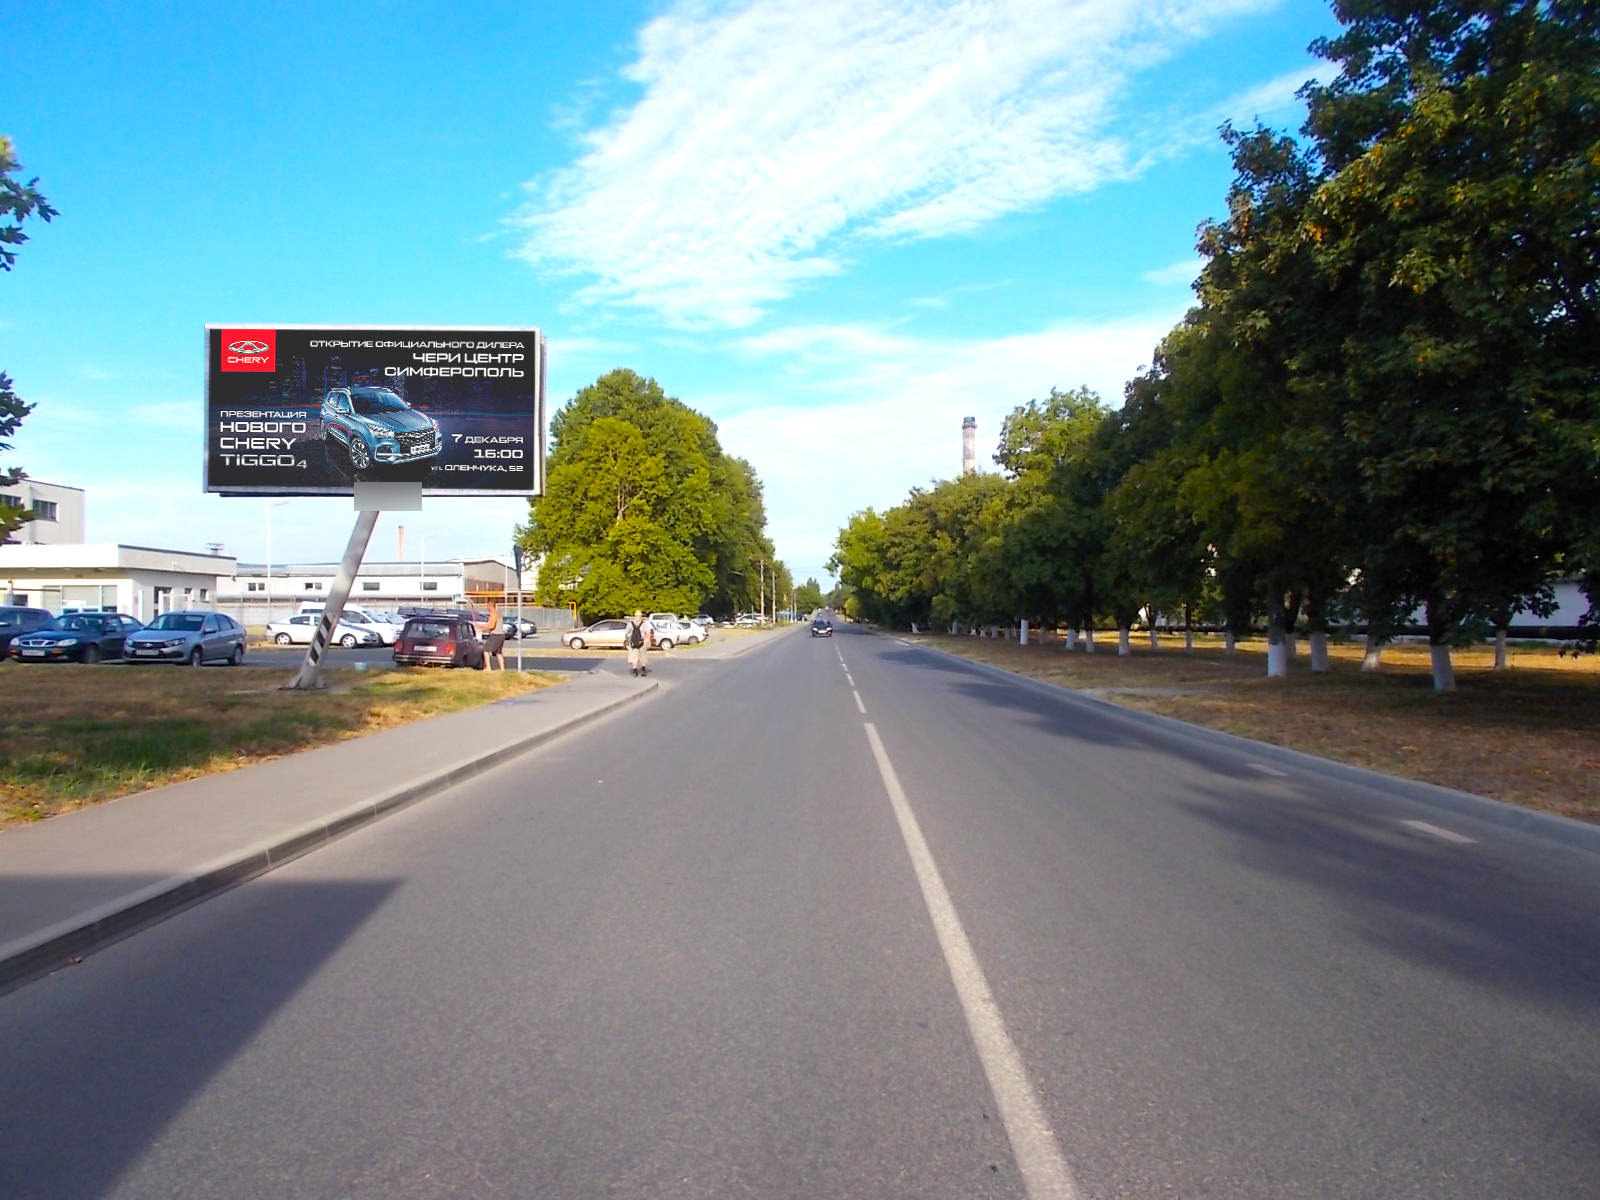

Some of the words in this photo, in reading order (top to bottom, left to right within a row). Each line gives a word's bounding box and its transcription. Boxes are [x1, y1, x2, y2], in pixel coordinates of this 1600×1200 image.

[309, 340, 374, 348] ОТКРЫТИЕ
[375, 340, 475, 349] ОФИЦИАЛЬНОГО
[476, 341, 525, 350] ДИЛЕРА
[227, 356, 270, 364] CHERY
[412, 352, 461, 363] ЧЕРИ
[464, 353, 525, 364] ЦЕНТР
[384, 366, 525, 378] СИМФЕРОПОЛЬ
[220, 410, 307, 419] ПРЕЗЕНТАЦИЯ
[220, 421, 306, 433] НОВОГО
[220, 437, 297, 450] CHERY
[451, 433, 463, 443] 7
[464, 436, 524, 444] ДЕКАБРЯ
[473, 449, 524, 459] 16:00
[219, 453, 295, 467] TIGGO
[296, 459, 308, 469] 4
